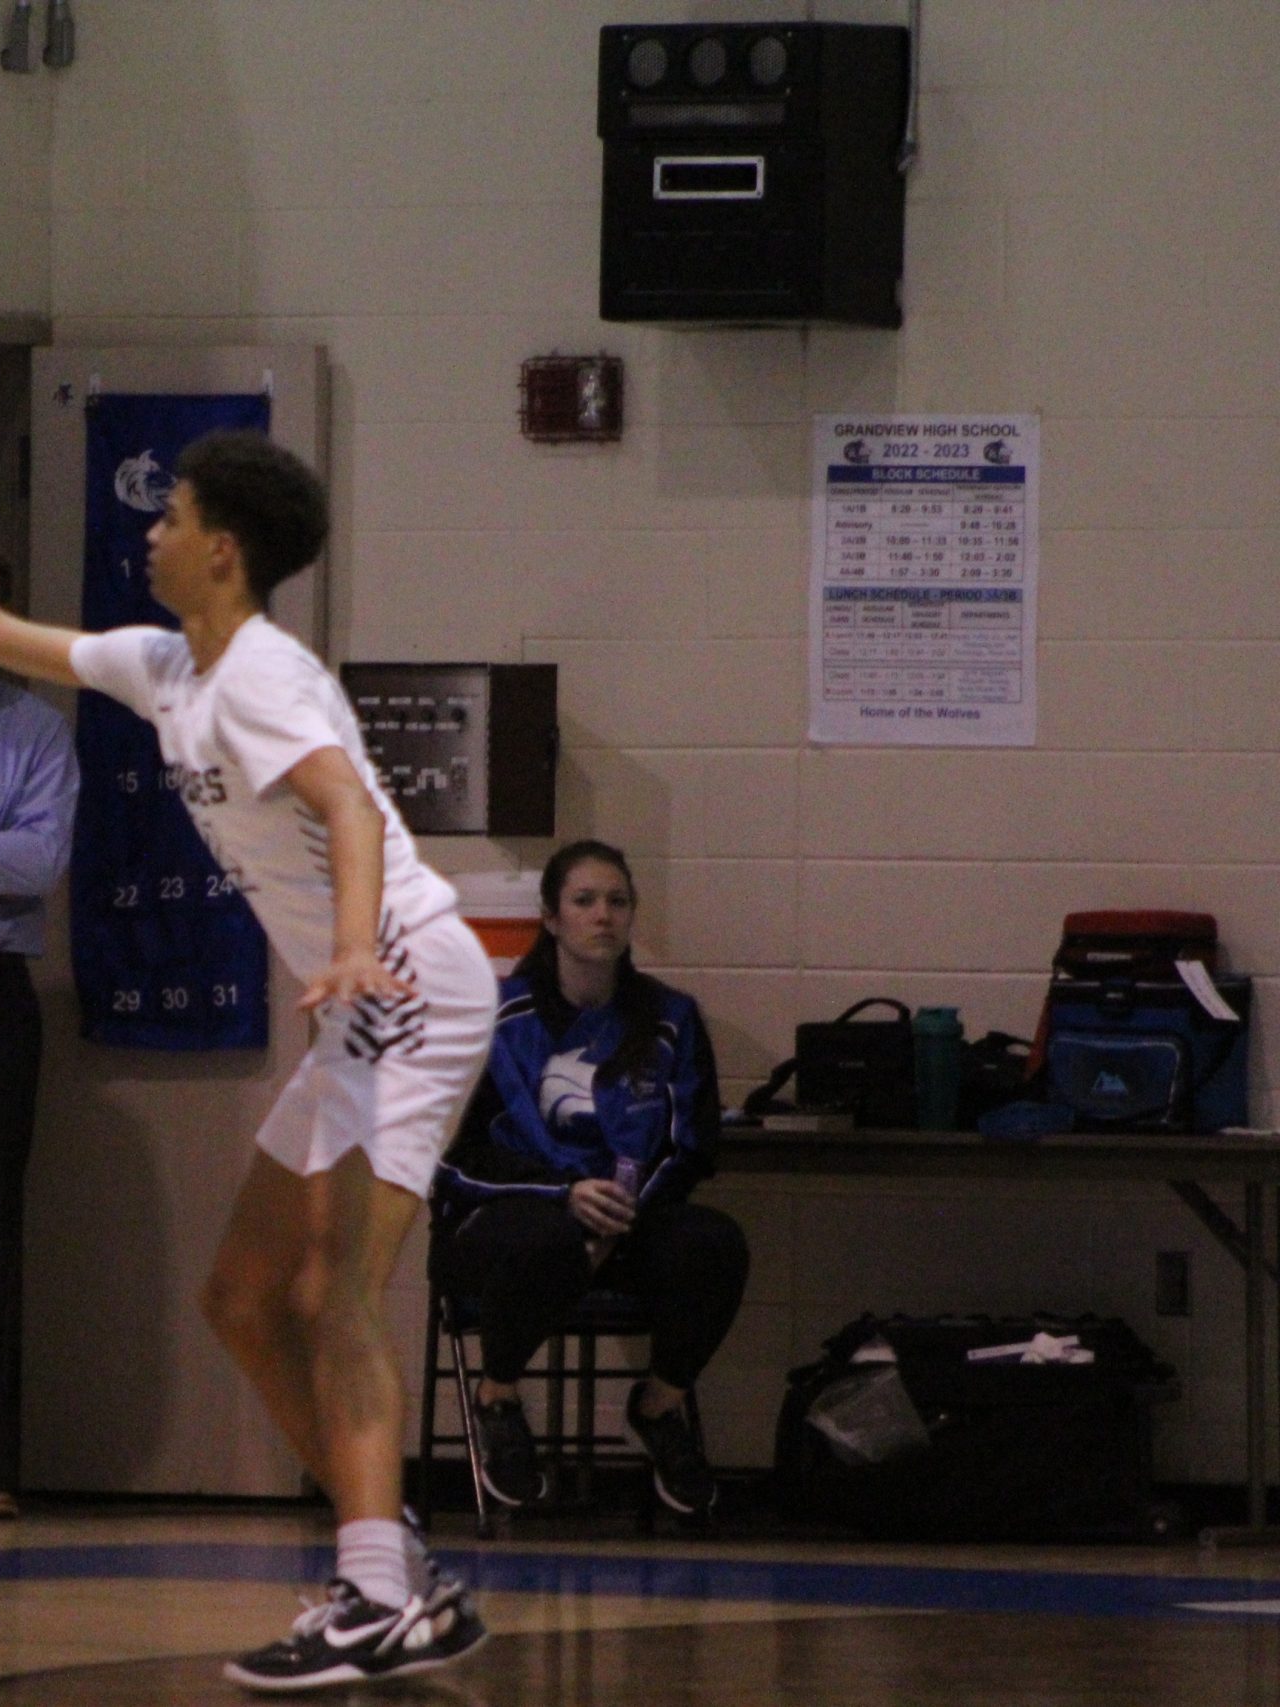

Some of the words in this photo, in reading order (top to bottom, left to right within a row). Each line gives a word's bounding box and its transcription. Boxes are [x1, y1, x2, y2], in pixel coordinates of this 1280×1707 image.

[834, 424, 919, 437] GRANDVIEW
[923, 424, 957, 437] HIGH
[961, 424, 1021, 437] SCHOOL
[883, 443, 919, 458] 2022
[933, 443, 970, 458] 2023
[872, 468, 912, 480] BLOCK
[916, 468, 981, 480] SCHEDULE
[828, 589, 869, 600] LUNCH
[871, 589, 930, 600] SCHEDULE
[940, 589, 982, 601] PERIOD
[859, 706, 894, 718] Home
[898, 706, 911, 718] of
[914, 707, 933, 718] the
[937, 707, 981, 719] Wolves
[117, 771, 138, 793] 15
[113, 885, 138, 908] 22
[160, 876, 184, 899] 23
[206, 875, 233, 897] 24
[112, 989, 141, 1012] 29
[162, 986, 188, 1009] 30
[212, 984, 237, 1007] 31
